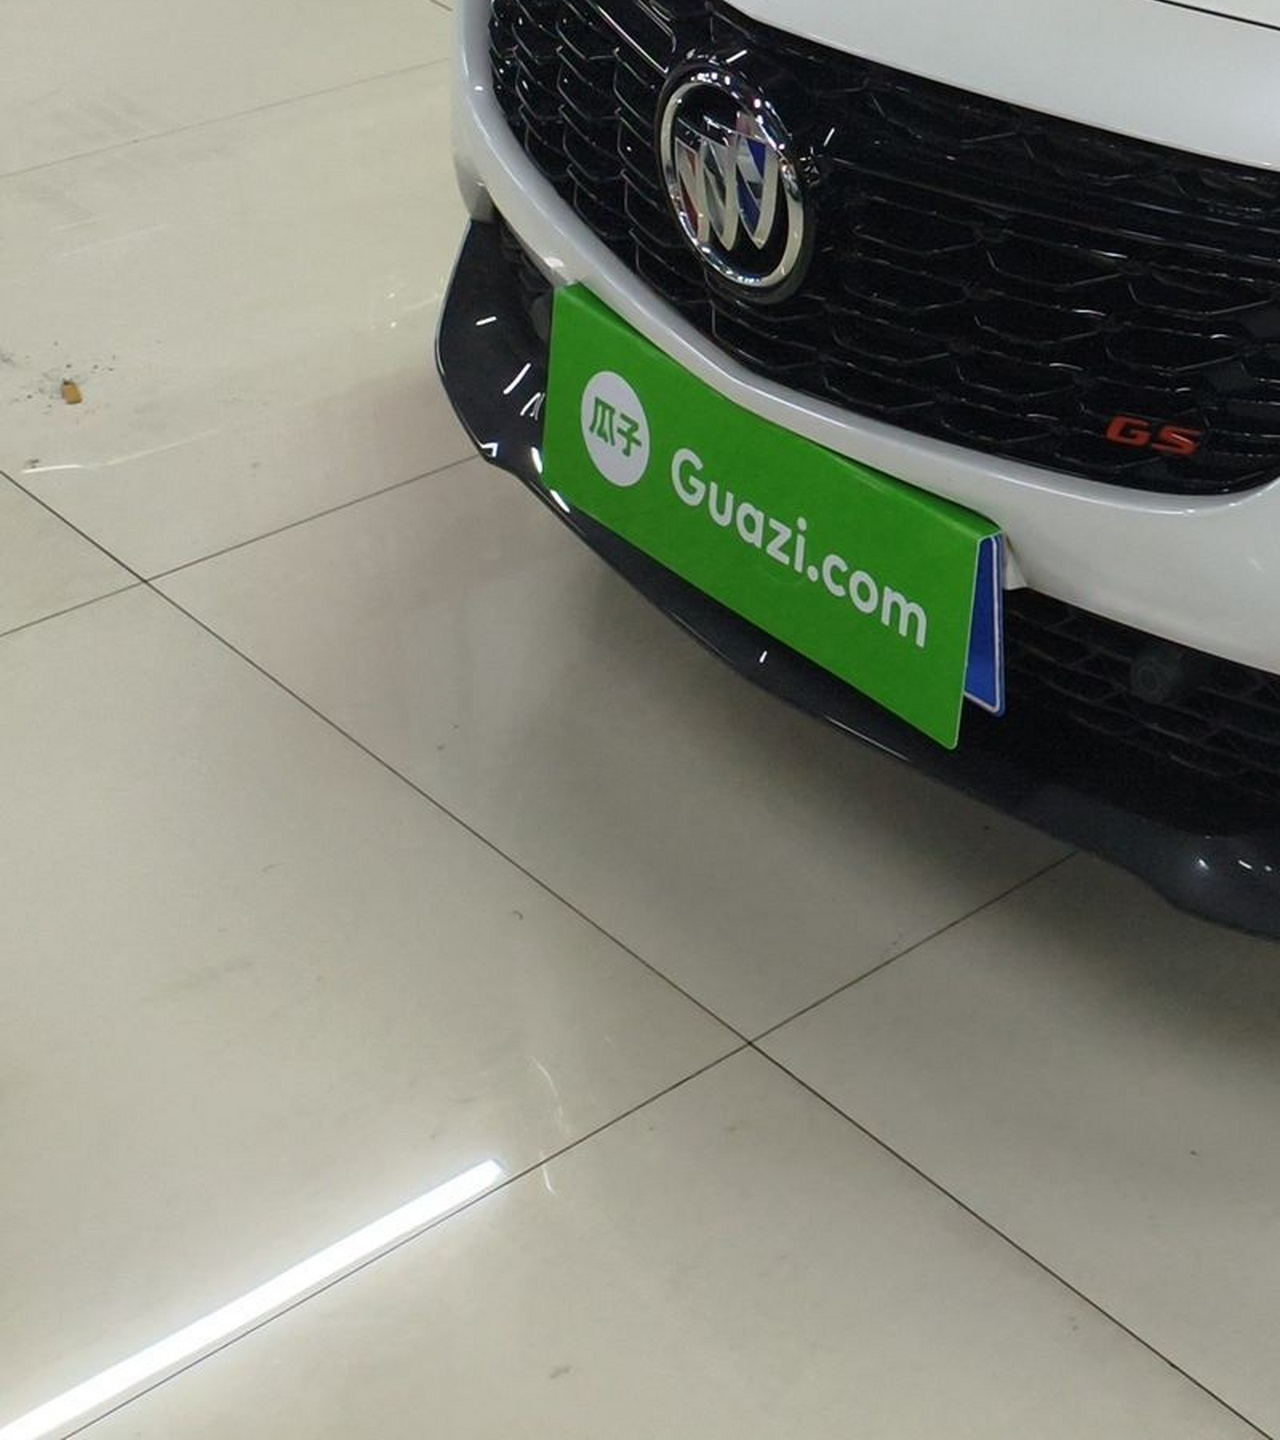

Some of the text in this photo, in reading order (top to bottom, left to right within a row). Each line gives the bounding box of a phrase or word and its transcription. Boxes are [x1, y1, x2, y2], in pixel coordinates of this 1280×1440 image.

[588, 396, 643, 457] 瓜子
[1106, 415, 1203, 456] GS
[670, 447, 928, 649] Guazi.com
